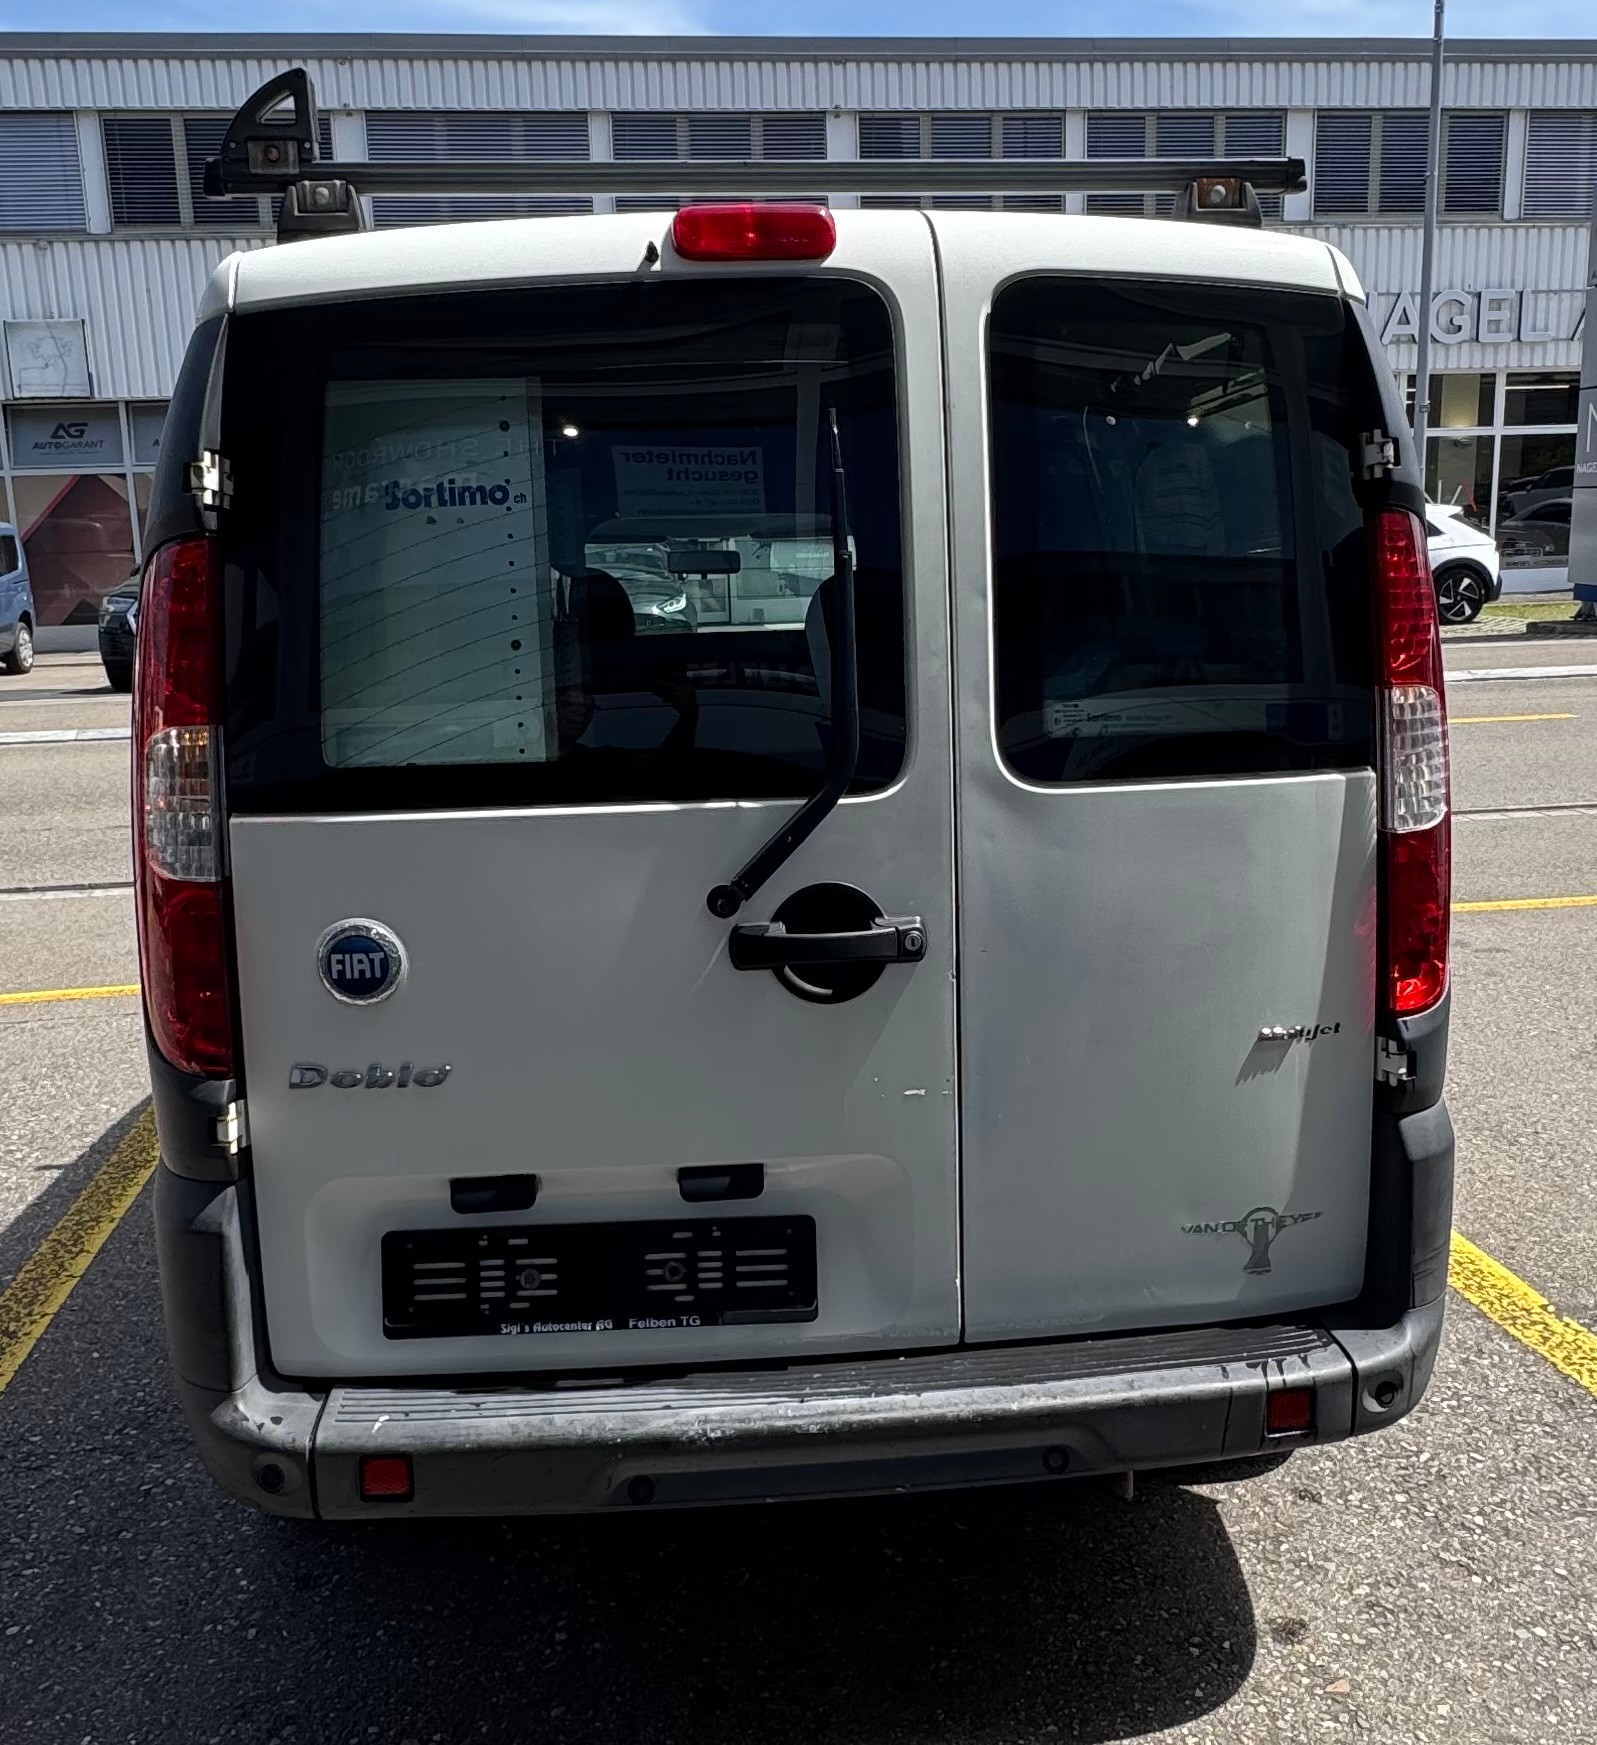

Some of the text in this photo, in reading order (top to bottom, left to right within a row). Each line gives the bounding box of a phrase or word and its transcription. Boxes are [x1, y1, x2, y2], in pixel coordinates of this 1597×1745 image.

[50, 422, 89, 439] AG
[32, 440, 105, 450] AUTOGARANT
[384, 478, 511, 511] Sortimo
[330, 952, 385, 980] FIAT
[532, 1321, 593, 1333] Autocenter
[680, 1315, 701, 1327] TG
